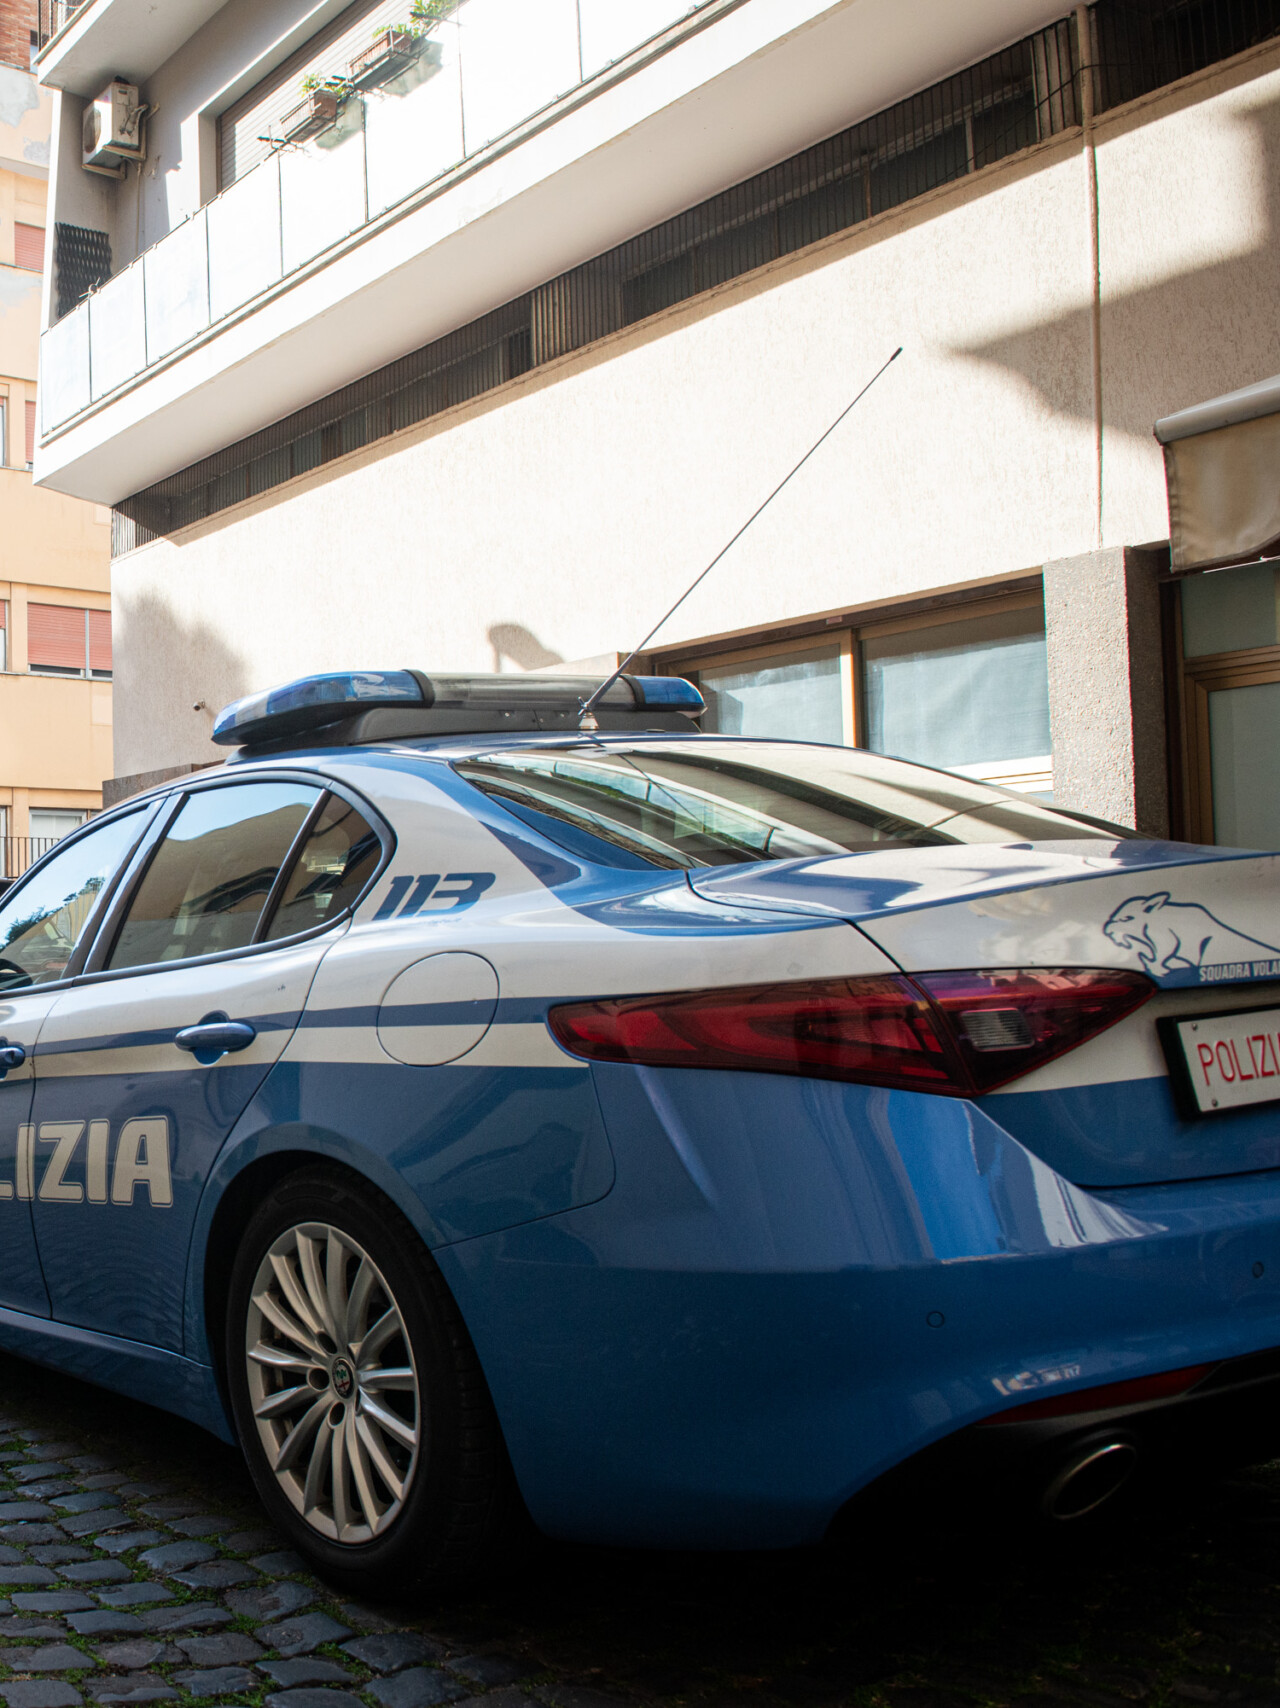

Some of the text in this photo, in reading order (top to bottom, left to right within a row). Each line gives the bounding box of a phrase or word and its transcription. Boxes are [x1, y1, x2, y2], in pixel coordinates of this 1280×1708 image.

[373, 871, 495, 921] 113
[1199, 963, 1251, 982] SQUADRA
[1196, 1033, 1280, 1087] POLIZI
